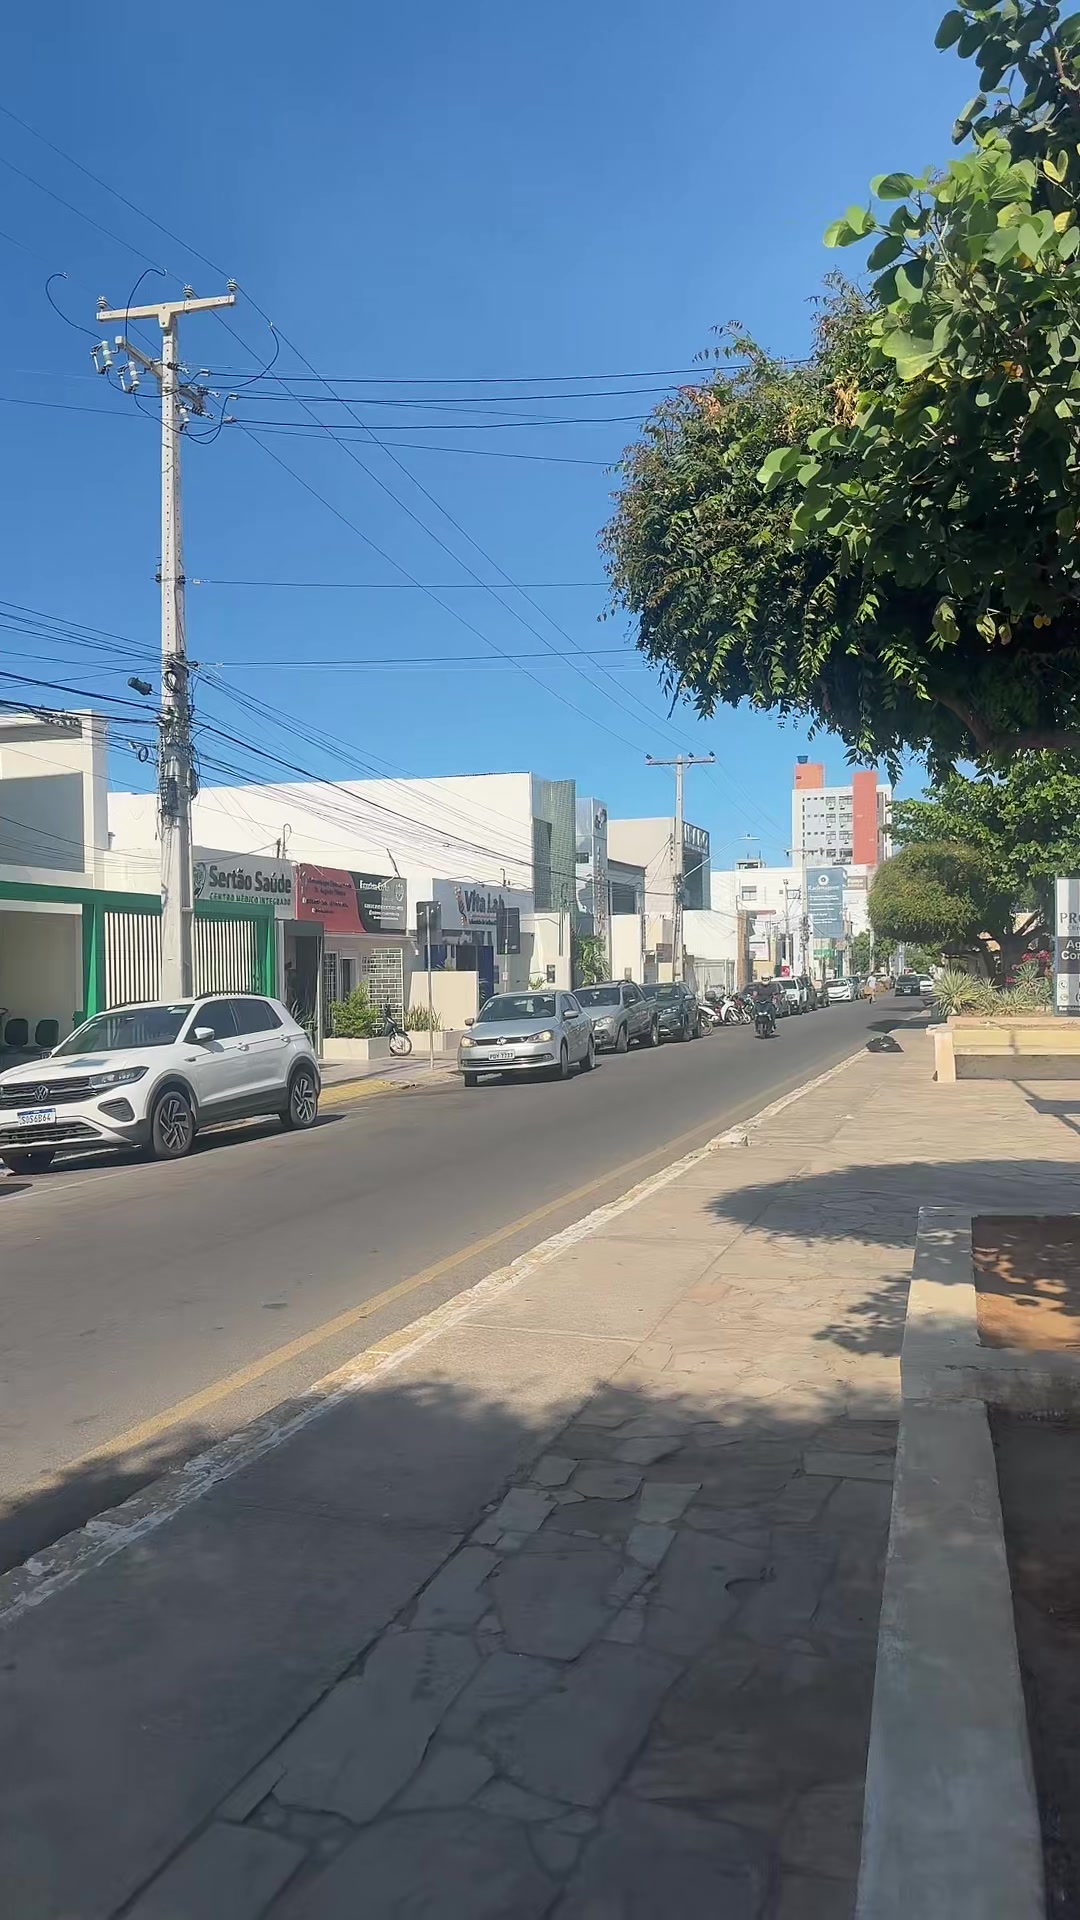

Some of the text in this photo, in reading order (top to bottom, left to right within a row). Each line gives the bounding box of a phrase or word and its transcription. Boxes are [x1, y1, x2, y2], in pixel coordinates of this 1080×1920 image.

[209, 865, 252, 890] Sertão
[255, 871, 291, 893] Saúde
[210, 892, 235, 901] CENTRO
[260, 896, 291, 905] INTEGRADO
[464, 890, 504, 913] Vita Lab
